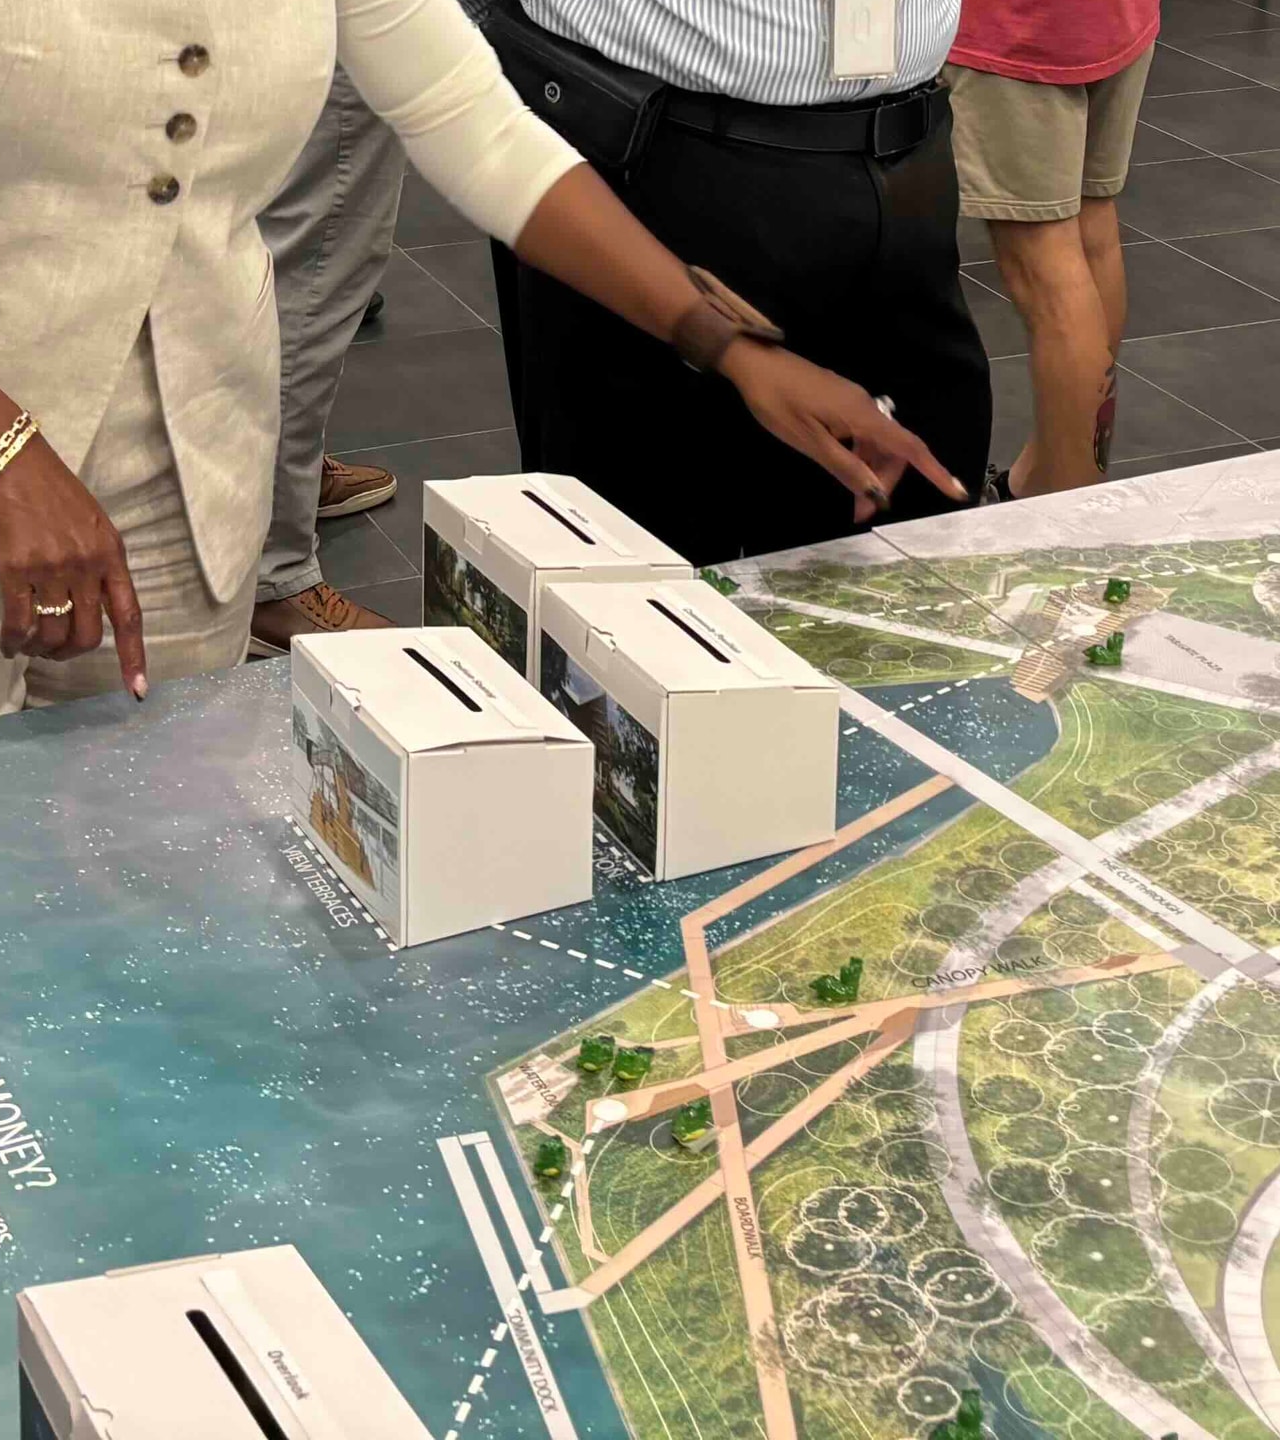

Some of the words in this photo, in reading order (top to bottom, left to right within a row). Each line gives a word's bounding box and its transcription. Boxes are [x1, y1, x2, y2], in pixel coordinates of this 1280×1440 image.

[282, 844, 317, 873] VIEW
[303, 871, 359, 928] TERRACES
[911, 964, 989, 989] CANOPY
[990, 956, 1049, 974] WALK
[519, 1062, 548, 1091] WATER
[733, 1196, 764, 1260] BOARDWALK
[267, 1350, 311, 1401] Overlook
[533, 1378, 559, 1413] DOCK
